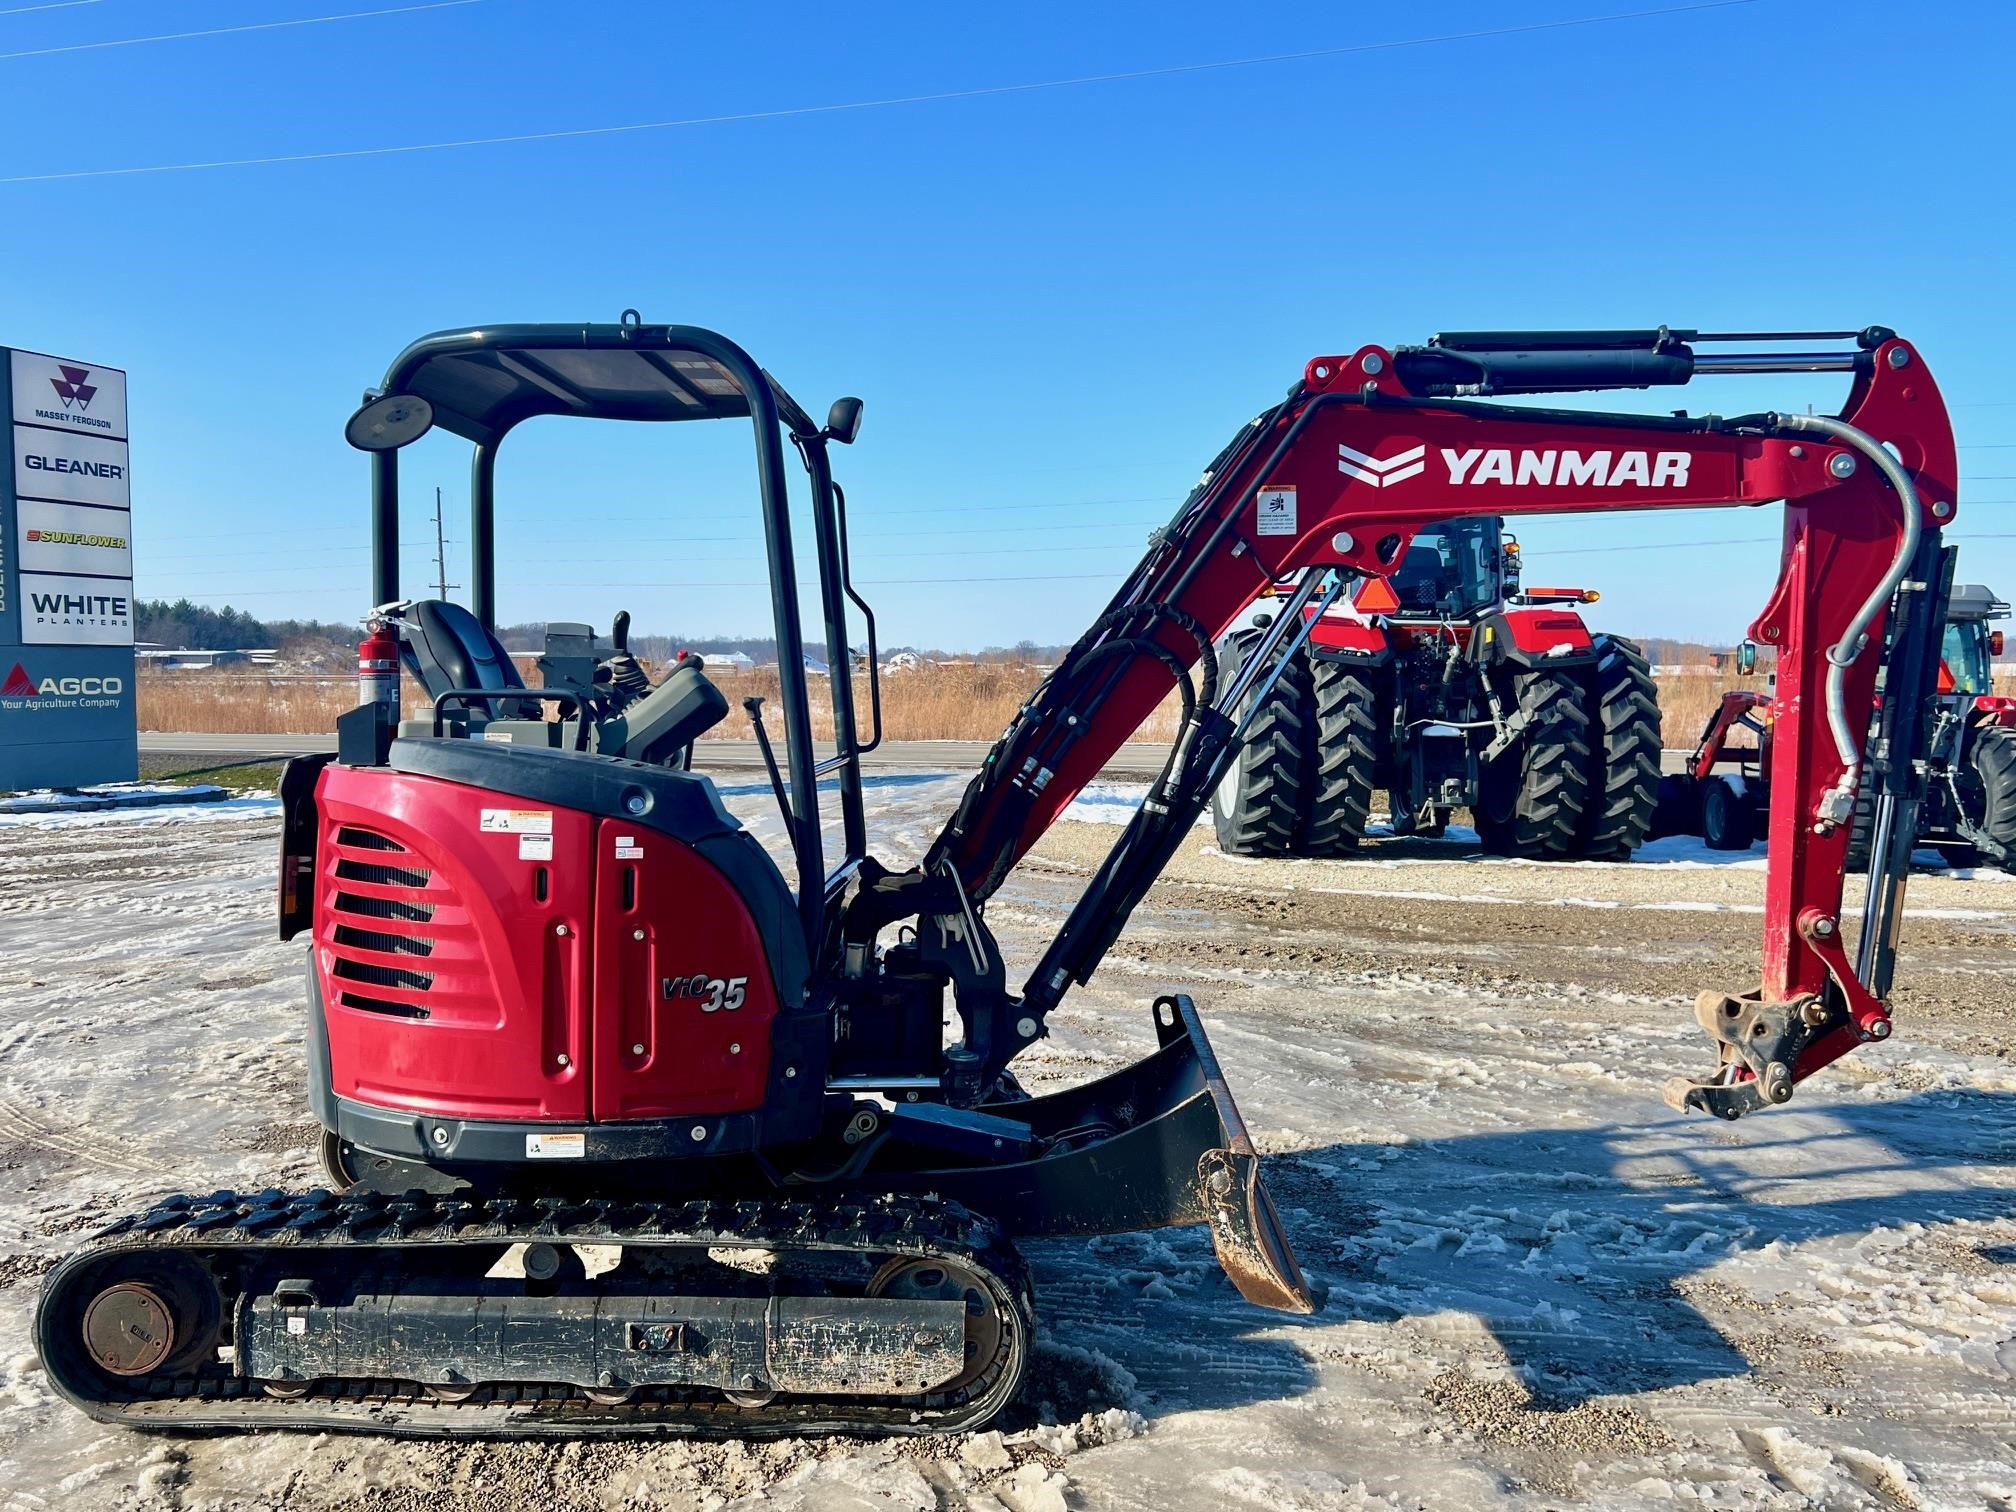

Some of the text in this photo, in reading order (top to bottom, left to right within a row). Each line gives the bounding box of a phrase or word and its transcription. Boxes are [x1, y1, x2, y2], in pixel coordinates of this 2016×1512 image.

[35, 409, 111, 429] MASSEY FERGUSON
[25, 454, 123, 480] GLEANER
[1440, 448, 1692, 488] YANMAR
[40, 530, 127, 549] SUNFLOWER
[31, 593, 128, 617] WHITE
[37, 617, 128, 627] PLANTERS
[38, 677, 123, 696] AGCO
[1, 697, 120, 711] Your Agriculture Company
